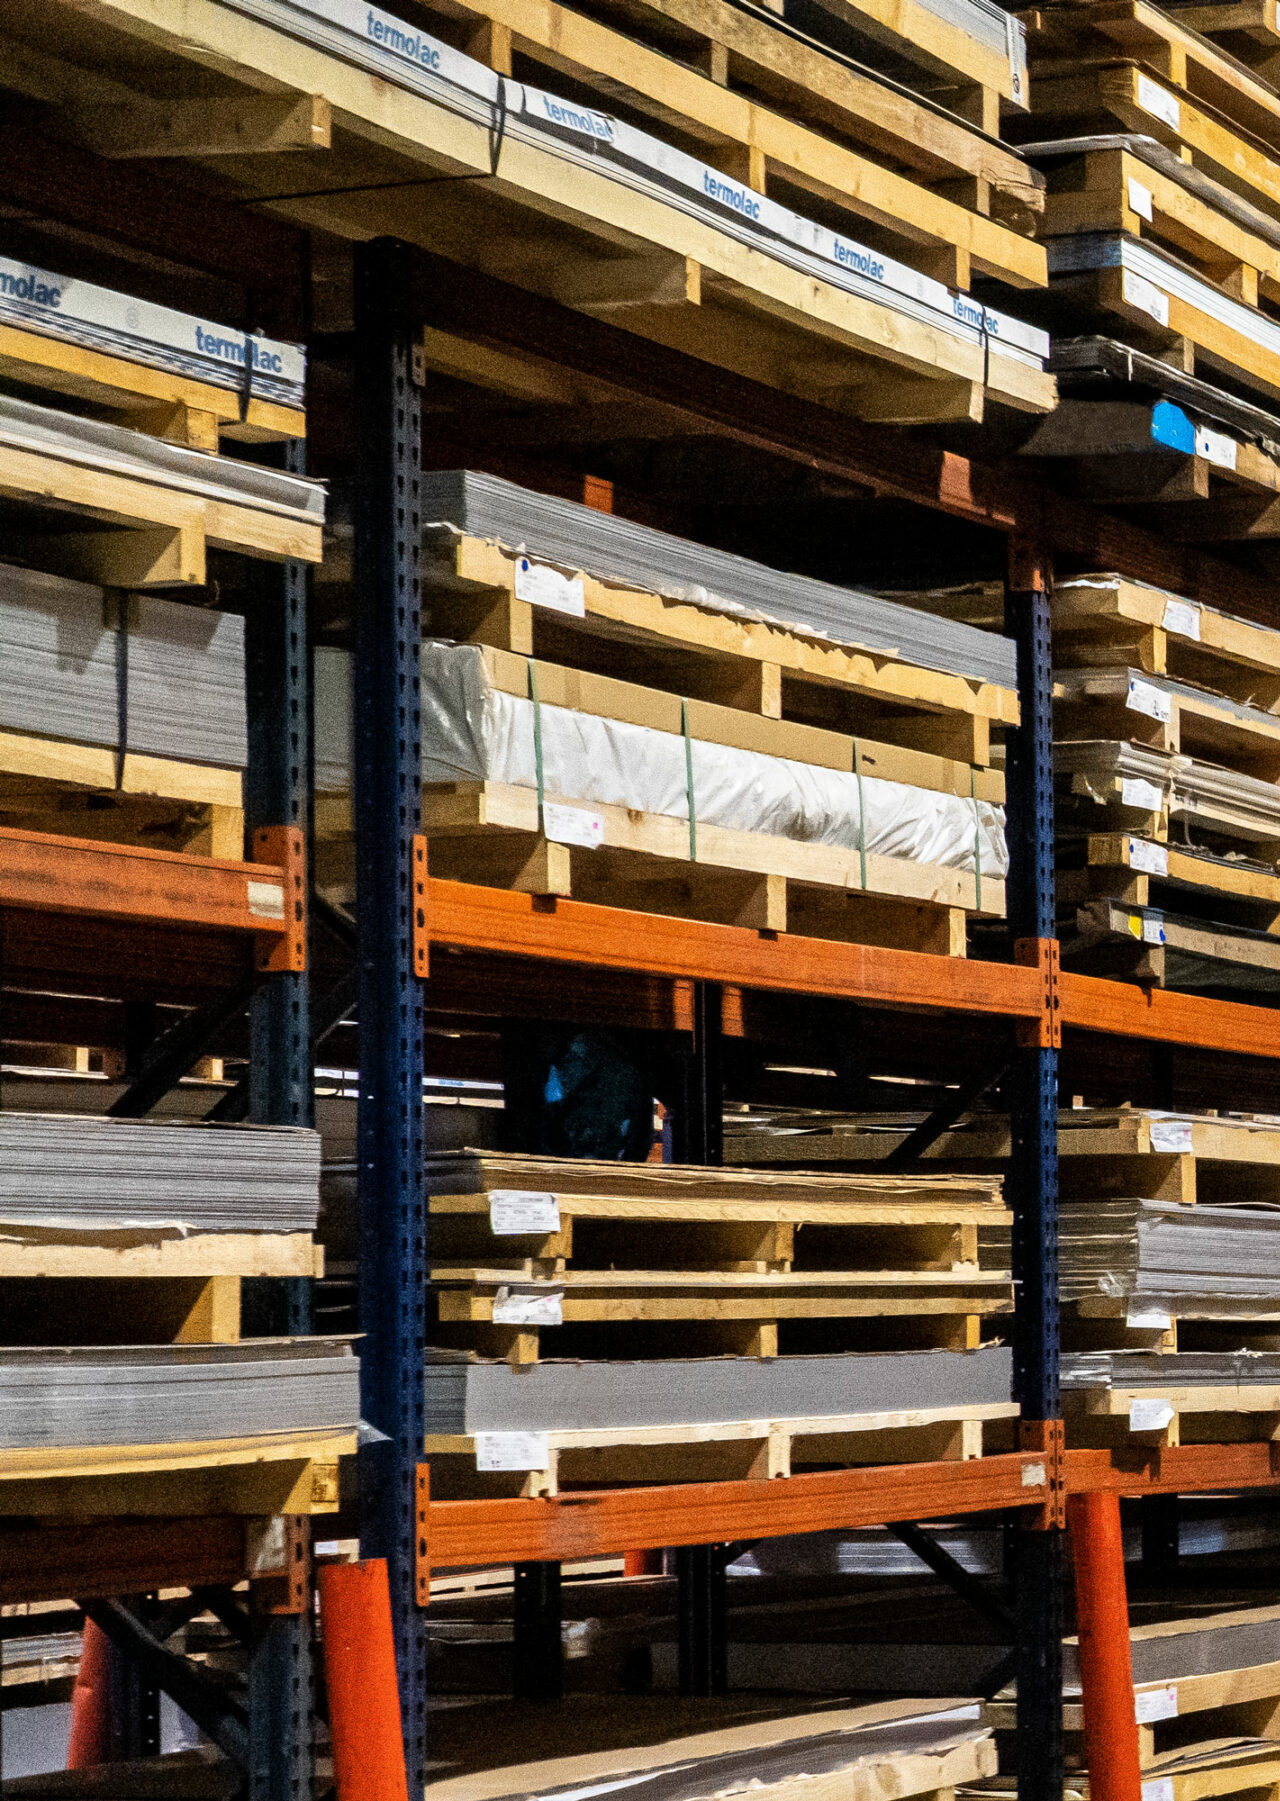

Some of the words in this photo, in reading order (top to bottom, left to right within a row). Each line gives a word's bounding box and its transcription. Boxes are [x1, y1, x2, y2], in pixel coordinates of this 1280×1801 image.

[367, 10, 440, 69] termolac
[704, 170, 760, 220] termolac
[834, 238, 884, 280] termolac
[953, 298, 999, 335] termoac
